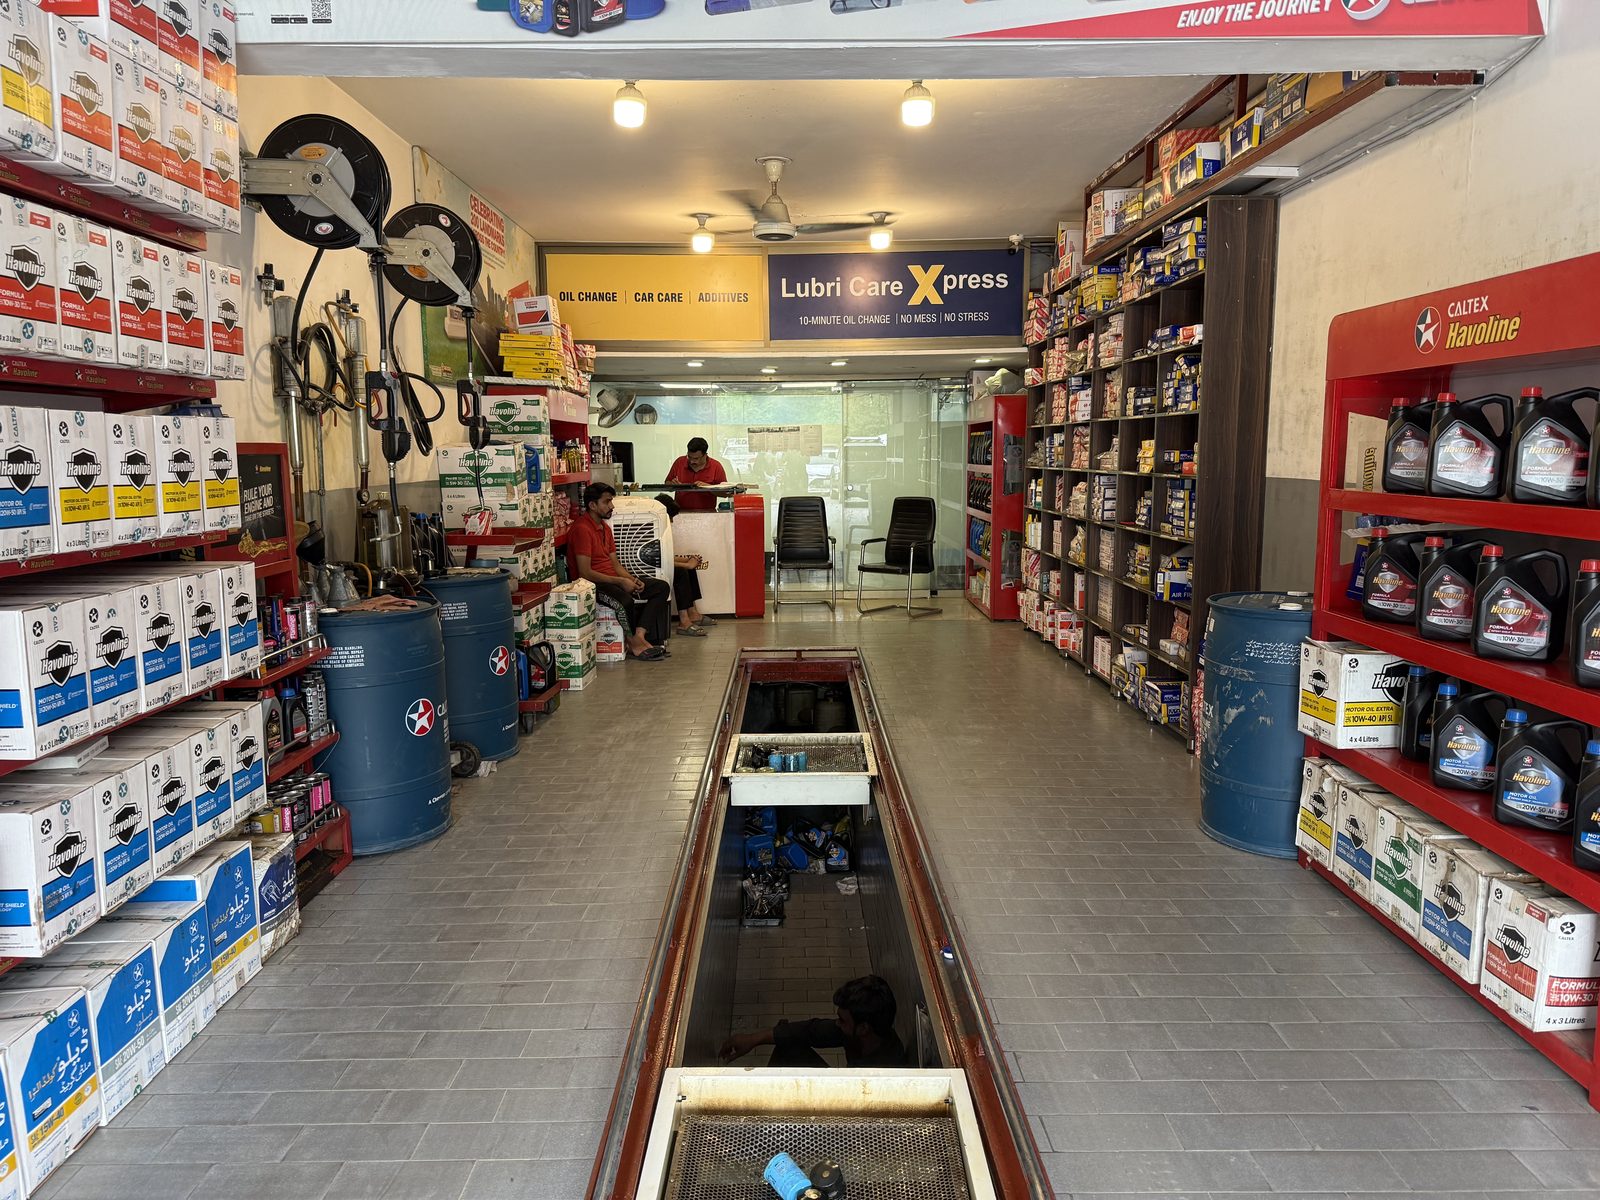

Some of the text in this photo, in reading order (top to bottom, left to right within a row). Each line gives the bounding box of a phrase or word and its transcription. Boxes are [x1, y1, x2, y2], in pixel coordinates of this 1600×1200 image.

[1177, 0, 1331, 28] ENJOY THE JOURNEY
[70, 79, 103, 106] Havoline
[63, 108, 86, 122] FORMULA
[126, 110, 156, 134] Havoline
[120, 137, 140, 149] FORMULA
[470, 194, 505, 234] CELEBRATING
[471, 213, 505, 247] 200 LANDMARKS
[491, 241, 505, 257] COUNTRY
[6, 254, 45, 278] Havoline
[69, 269, 102, 291] Havoline
[781, 264, 1009, 306] Lubri Care Xpress
[126, 283, 155, 302] Havoline
[559, 291, 618, 302] OIL CHANGE
[634, 292, 683, 303] CAR CARE
[698, 292, 749, 303] ADDITIVES
[61, 301, 84, 312] FORMULA
[173, 294, 198, 312] Havoline
[1447, 295, 1489, 318] CALTEX
[121, 313, 140, 322] FORMULA
[217, 305, 239, 322] Havoline
[799, 315, 891, 326] 10-MINUTE OIL CHANGE
[900, 314, 937, 323] NO MESS
[944, 312, 989, 322] NO STRESS
[168, 322, 185, 331] FORMULA
[1445, 314, 1521, 350] Havoline
[489, 406, 521, 415] Havoline
[1443, 445, 1480, 454] Havoline
[1, 460, 41, 475] Havoline
[67, 462, 101, 477] Havoline
[120, 461, 151, 475] Havoline
[168, 460, 195, 473] Havoline
[209, 458, 232, 471] Havoline
[459, 456, 493, 468] Havline
[244, 483, 272, 501] RULE YOUR
[244, 496, 274, 513] ENGINE AND
[5, 548, 10, 556] 3
[10, 547, 24, 556] Litres
[1372, 576, 1403, 586] Havoline
[1432, 590, 1469, 600] Havoline
[232, 600, 253, 616] Havoline
[1490, 604, 1532, 617] Havoline
[192, 610, 216, 627] Havoline
[146, 622, 175, 641] Havoline
[96, 636, 129, 658] Havoline
[41, 650, 79, 675] Havoline
[93, 677, 105, 685] MOTOR
[1372, 673, 1406, 689] Havo
[38, 694, 54, 705] MOTOR
[1352, 714, 1377, 723] 10W-40
[1379, 714, 1387, 722] API
[236, 741, 259, 762] Havoline
[1447, 740, 1481, 752] Havoline
[199, 763, 225, 785] Havoline
[1456, 768, 1477, 777] 20W-50
[1512, 772, 1551, 786] Havoline
[157, 782, 186, 810] Havoline
[1509, 791, 1527, 799] MOTOR
[1522, 804, 1546, 812] 20W-50
[109, 810, 142, 839] Havoline
[49, 839, 87, 872] Havoline
[1384, 841, 1413, 871] Havoline
[1434, 885, 1465, 915] Hvoline
[1424, 907, 1448, 927] MOTOR OIL
[1495, 928, 1530, 960] Havoline
[1487, 950, 1507, 968] FORMULA
[1551, 981, 1599, 990] FORMUL
[124, 981, 151, 1023] ڈیلو
[1560, 993, 1593, 1003] 10W-30
[1565, 1016, 1586, 1024] Litres
[57, 1029, 89, 1081] ڈیلو
[114, 1036, 145, 1070] SAE 20W-50
[30, 1134, 38, 1145] SAE
[39, 1107, 65, 1136] 15W-40
